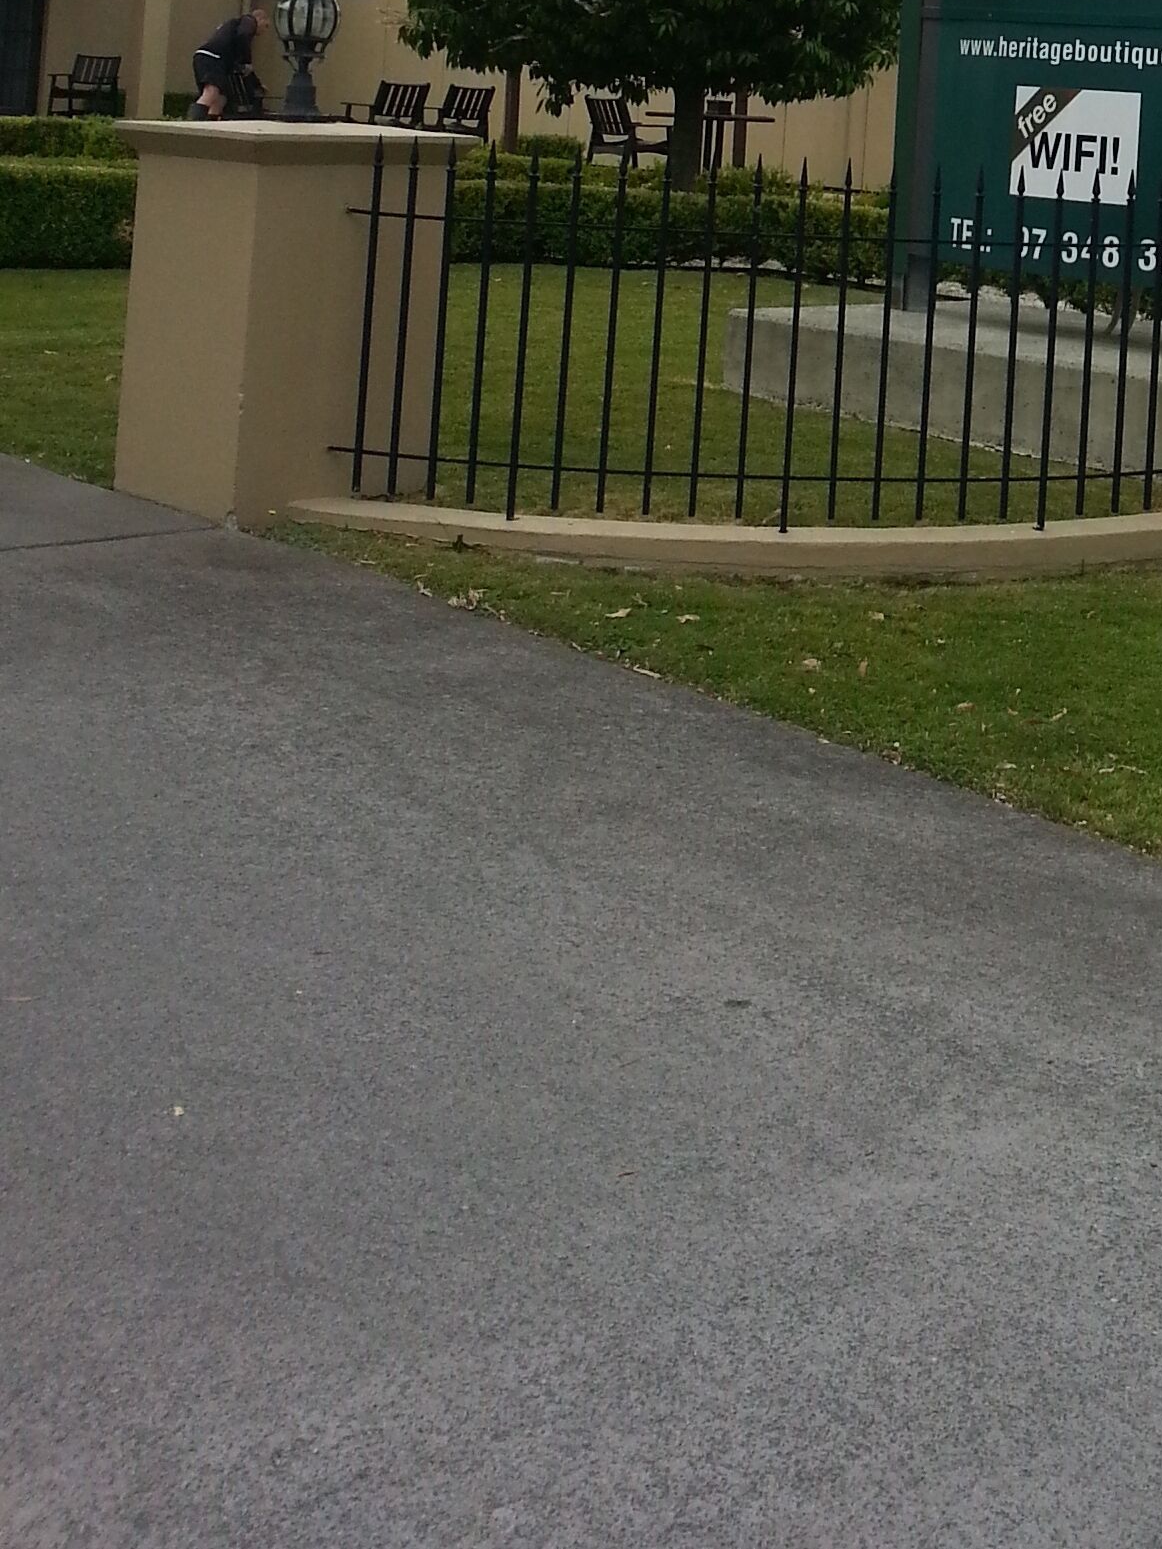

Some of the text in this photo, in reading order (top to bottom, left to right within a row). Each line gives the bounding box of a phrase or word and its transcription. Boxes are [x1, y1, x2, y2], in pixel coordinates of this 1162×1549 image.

[1018, 93, 1057, 139] free
[1029, 131, 1120, 176] WIFI!
[950, 217, 992, 253] TE:
